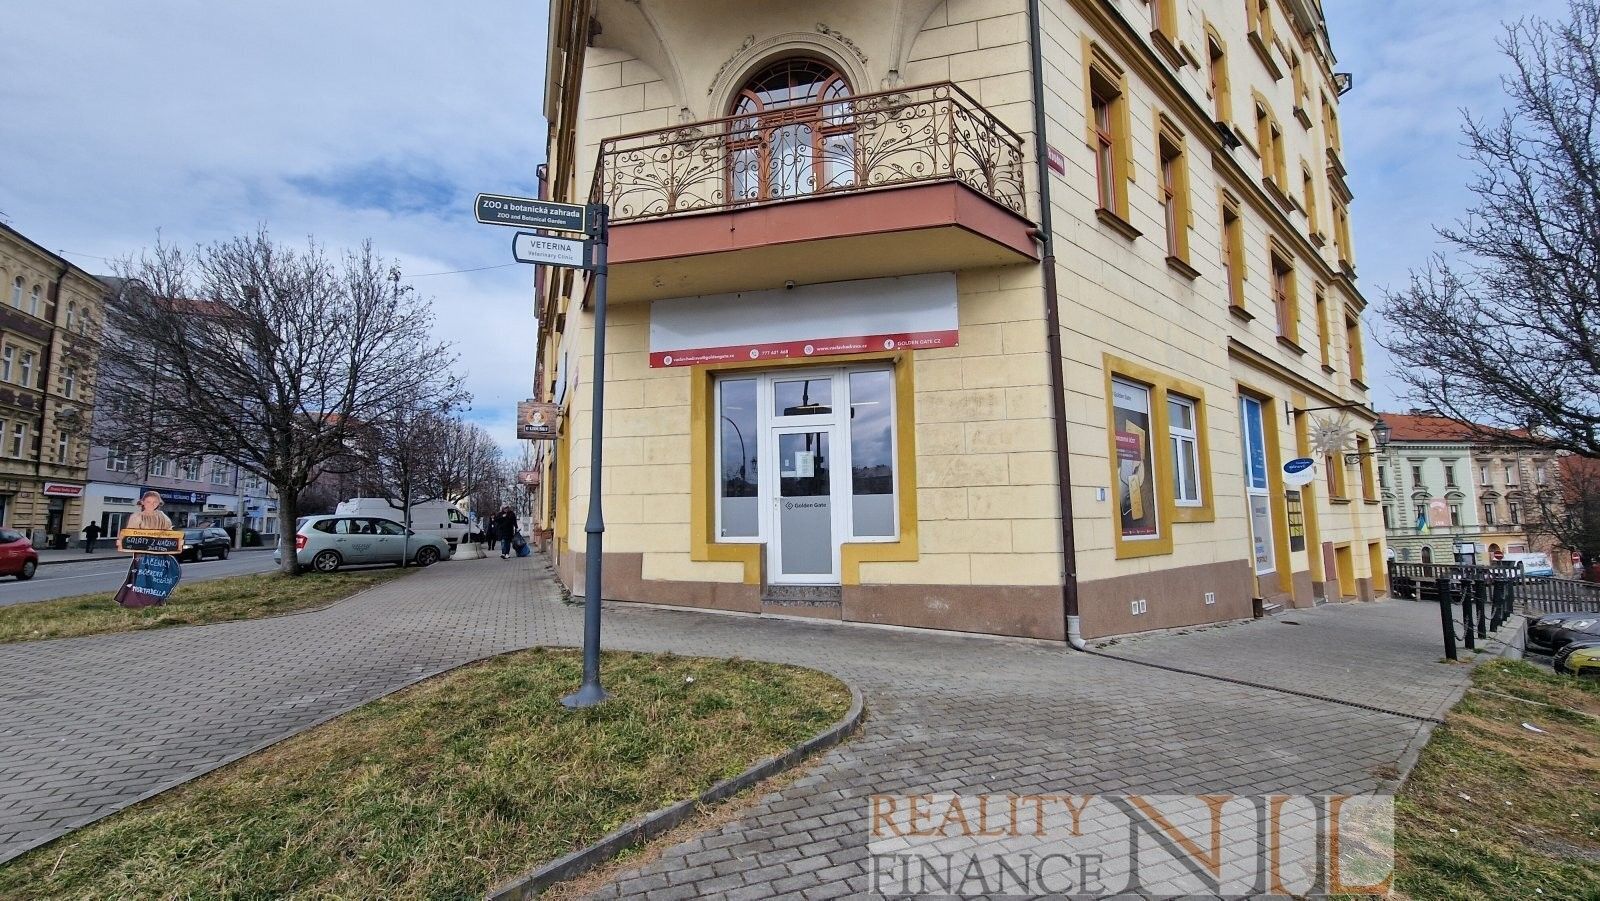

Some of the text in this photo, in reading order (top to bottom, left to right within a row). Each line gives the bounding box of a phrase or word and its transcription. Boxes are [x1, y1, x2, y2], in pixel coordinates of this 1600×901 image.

[483, 200, 501, 209] ZOO
[510, 203, 549, 214] botanická
[550, 208, 580, 218] zahrada
[522, 214, 547, 223] Botanical
[547, 217, 566, 225] Garden
[530, 240, 571, 252] VETERINA
[528, 250, 573, 261] Veterinary Clinic
